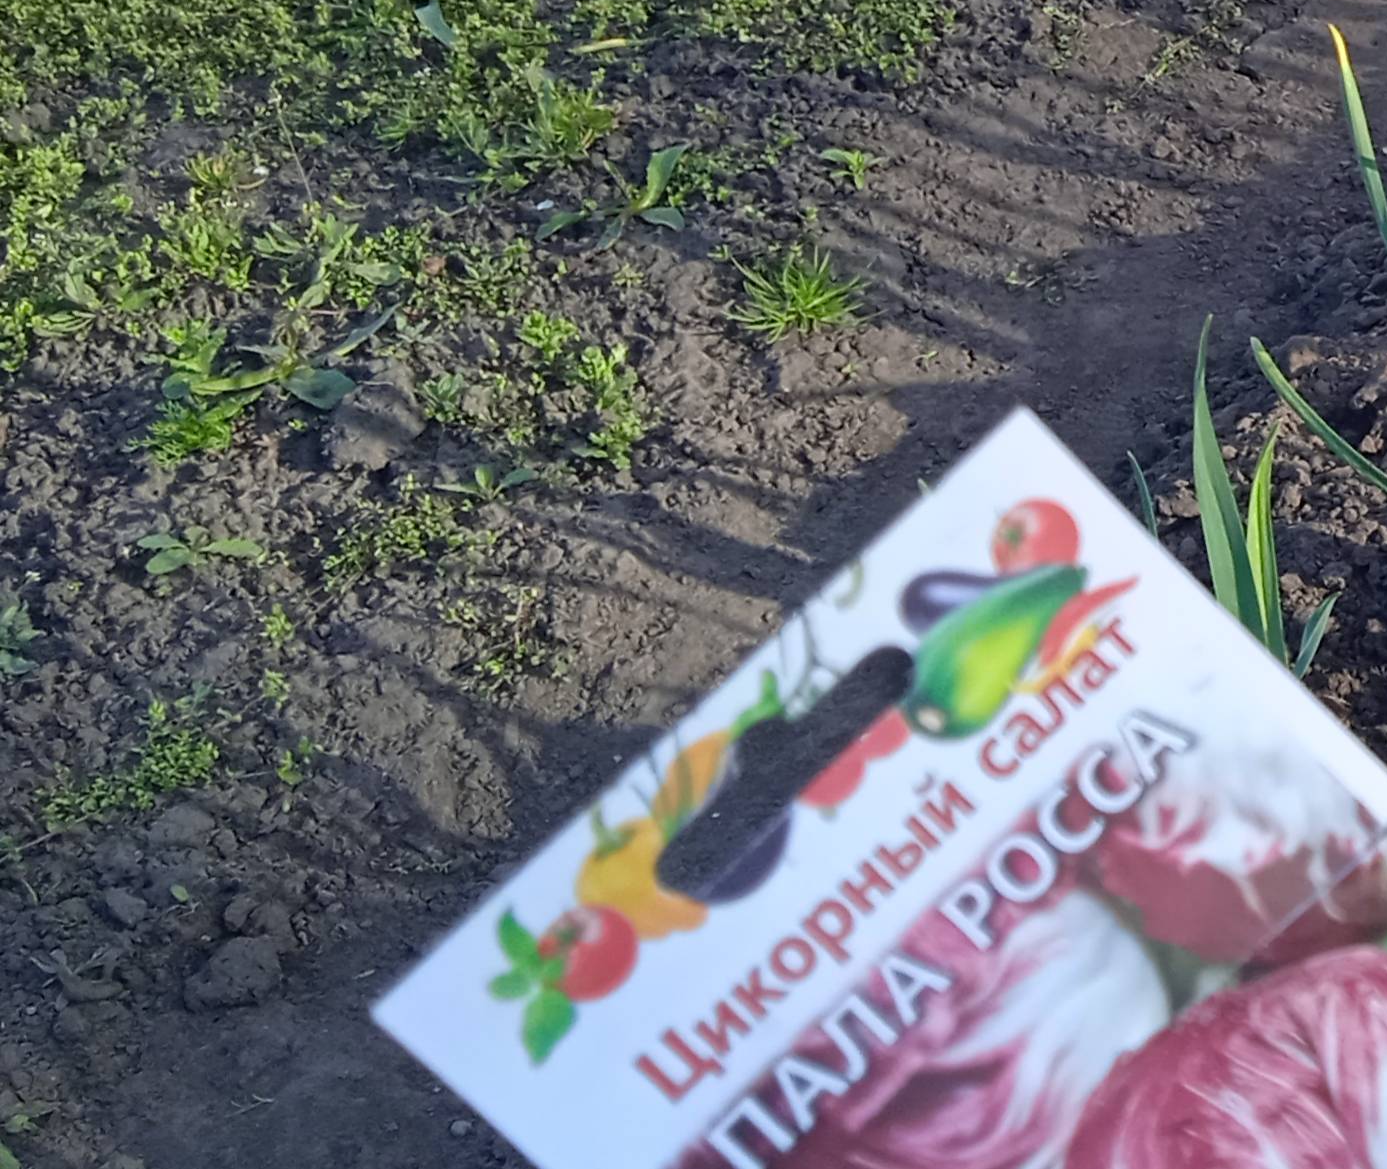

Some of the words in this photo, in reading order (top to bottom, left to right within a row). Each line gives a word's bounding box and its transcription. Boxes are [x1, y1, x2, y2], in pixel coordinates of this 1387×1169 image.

[633, 773, 976, 1102] Цикорный
[978, 618, 1137, 778] салат
[705, 954, 952, 1169] ПАЛА
[940, 712, 1194, 952] РОССА
